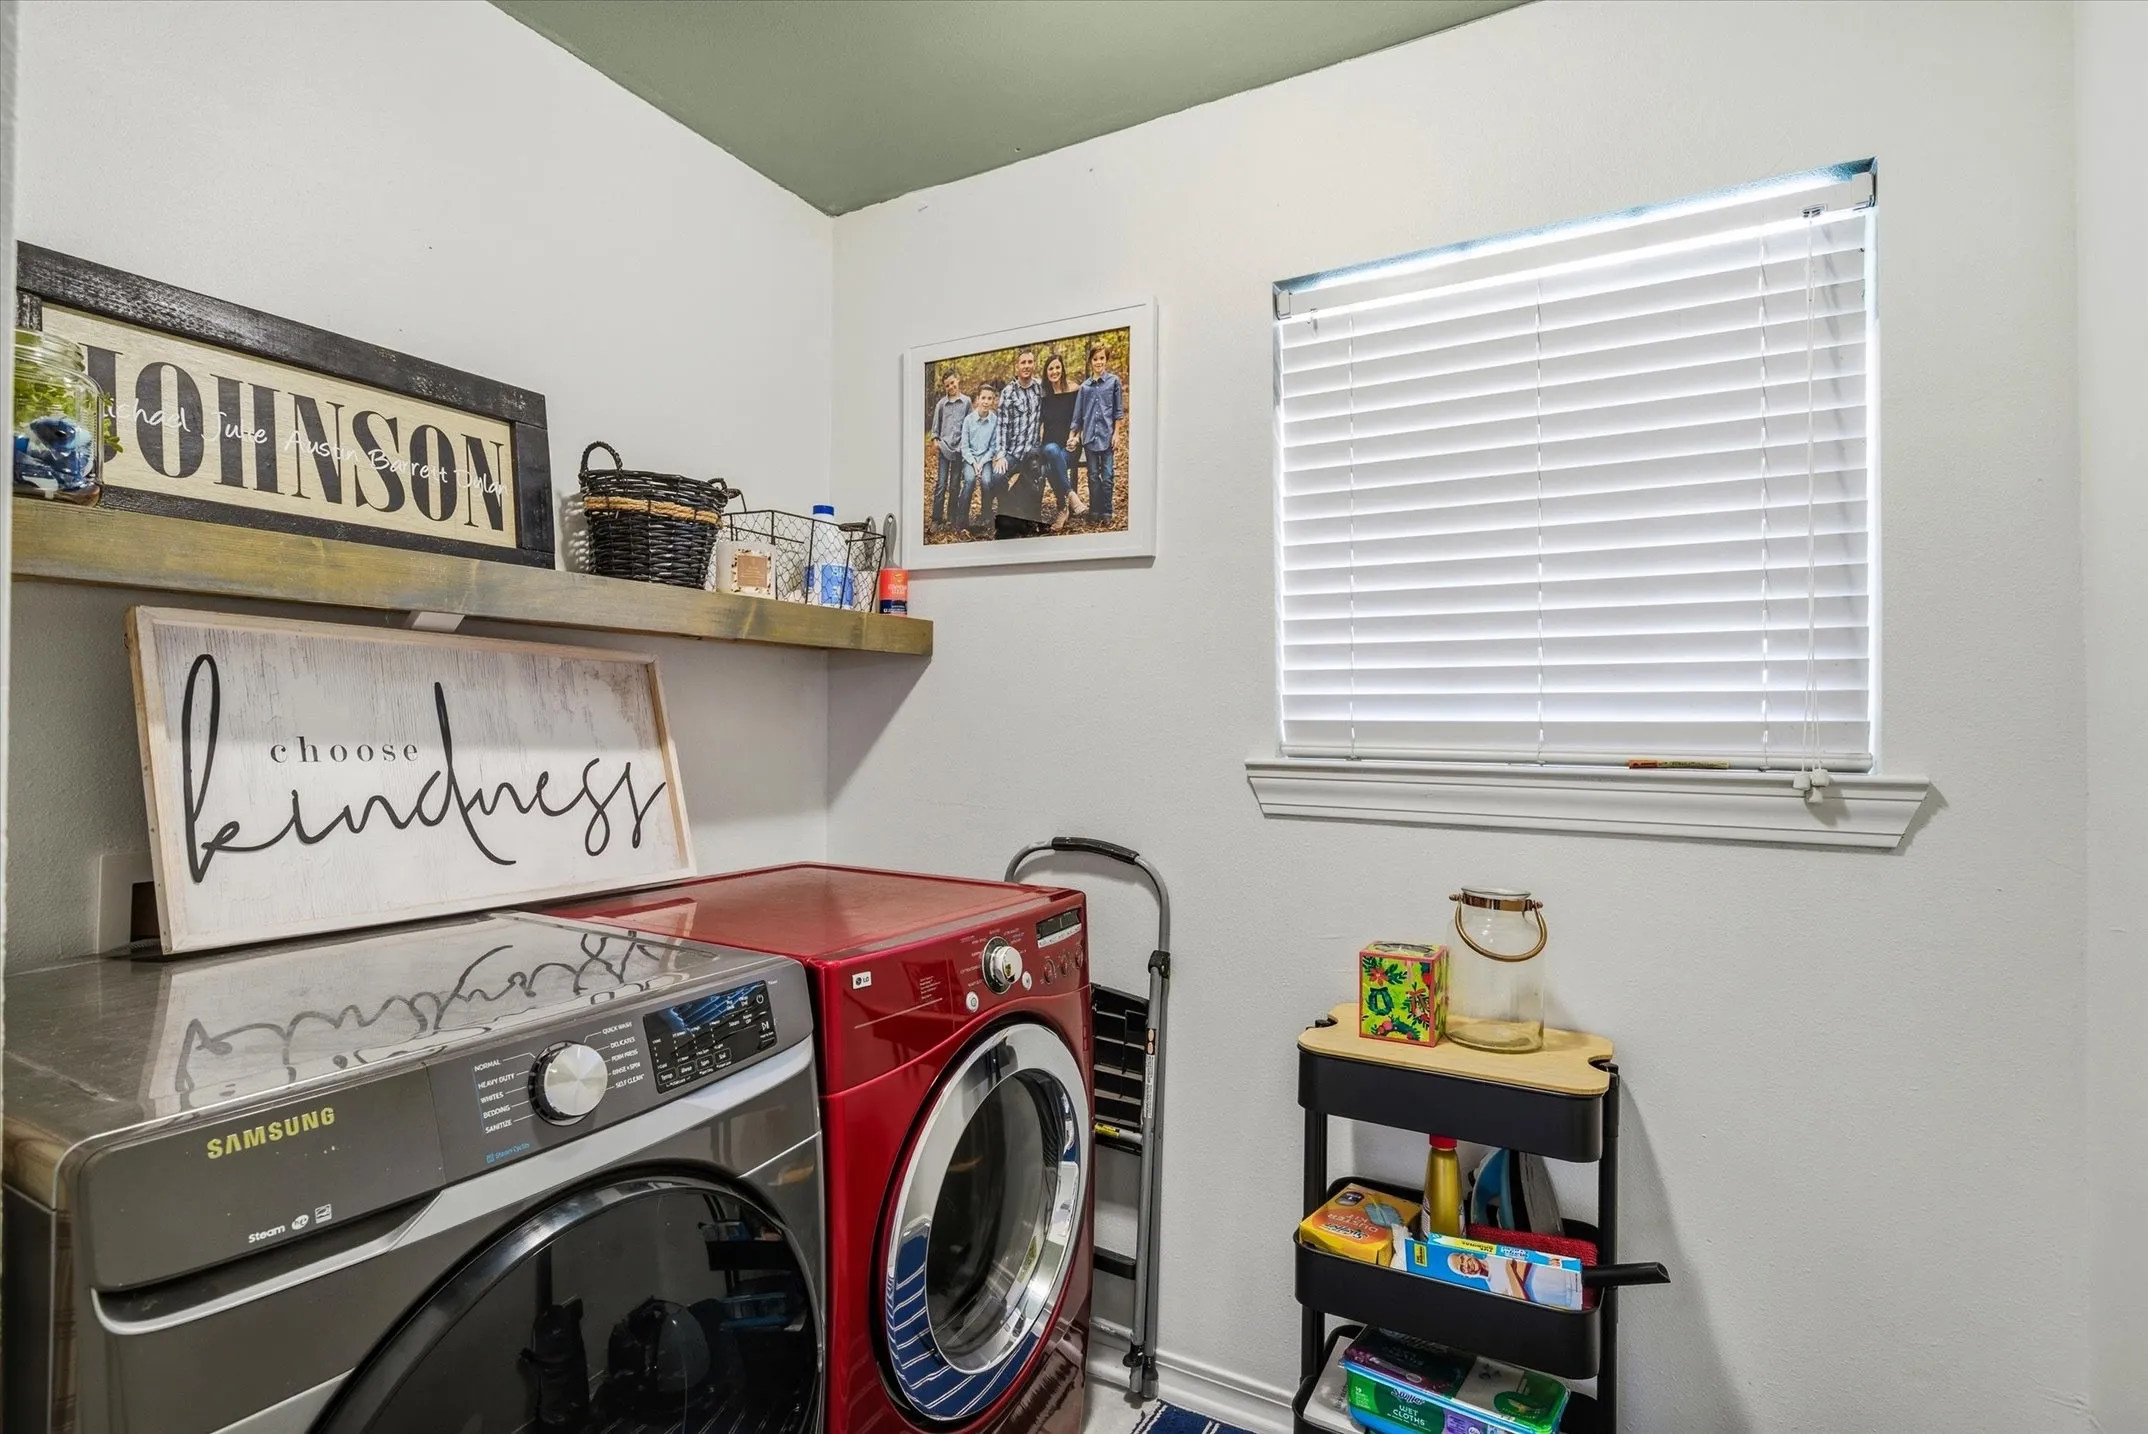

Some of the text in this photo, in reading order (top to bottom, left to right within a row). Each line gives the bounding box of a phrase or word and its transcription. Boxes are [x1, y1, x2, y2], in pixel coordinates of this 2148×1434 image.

[104, 398, 509, 498] ichael Julie Austin Barrett Dylan
[270, 736, 420, 764] choose
[181, 653, 667, 883] kindness
[602, 1025, 617, 1035] QUICK
[610, 1035, 636, 1049] DELICATES
[474, 1058, 501, 1073] NORMAL
[477, 1072, 515, 1090] HEAVY DUTY
[480, 1091, 504, 1104] WHITES
[482, 1104, 511, 1120] BEDDING
[207, 1107, 335, 1159] SAMSUNG
[485, 1119, 513, 1134] SANITIZE
[248, 1224, 286, 1244] Steam
[1392, 1408, 1426, 1427] CLOTHS
[1398, 1404, 1419, 1416] WET
